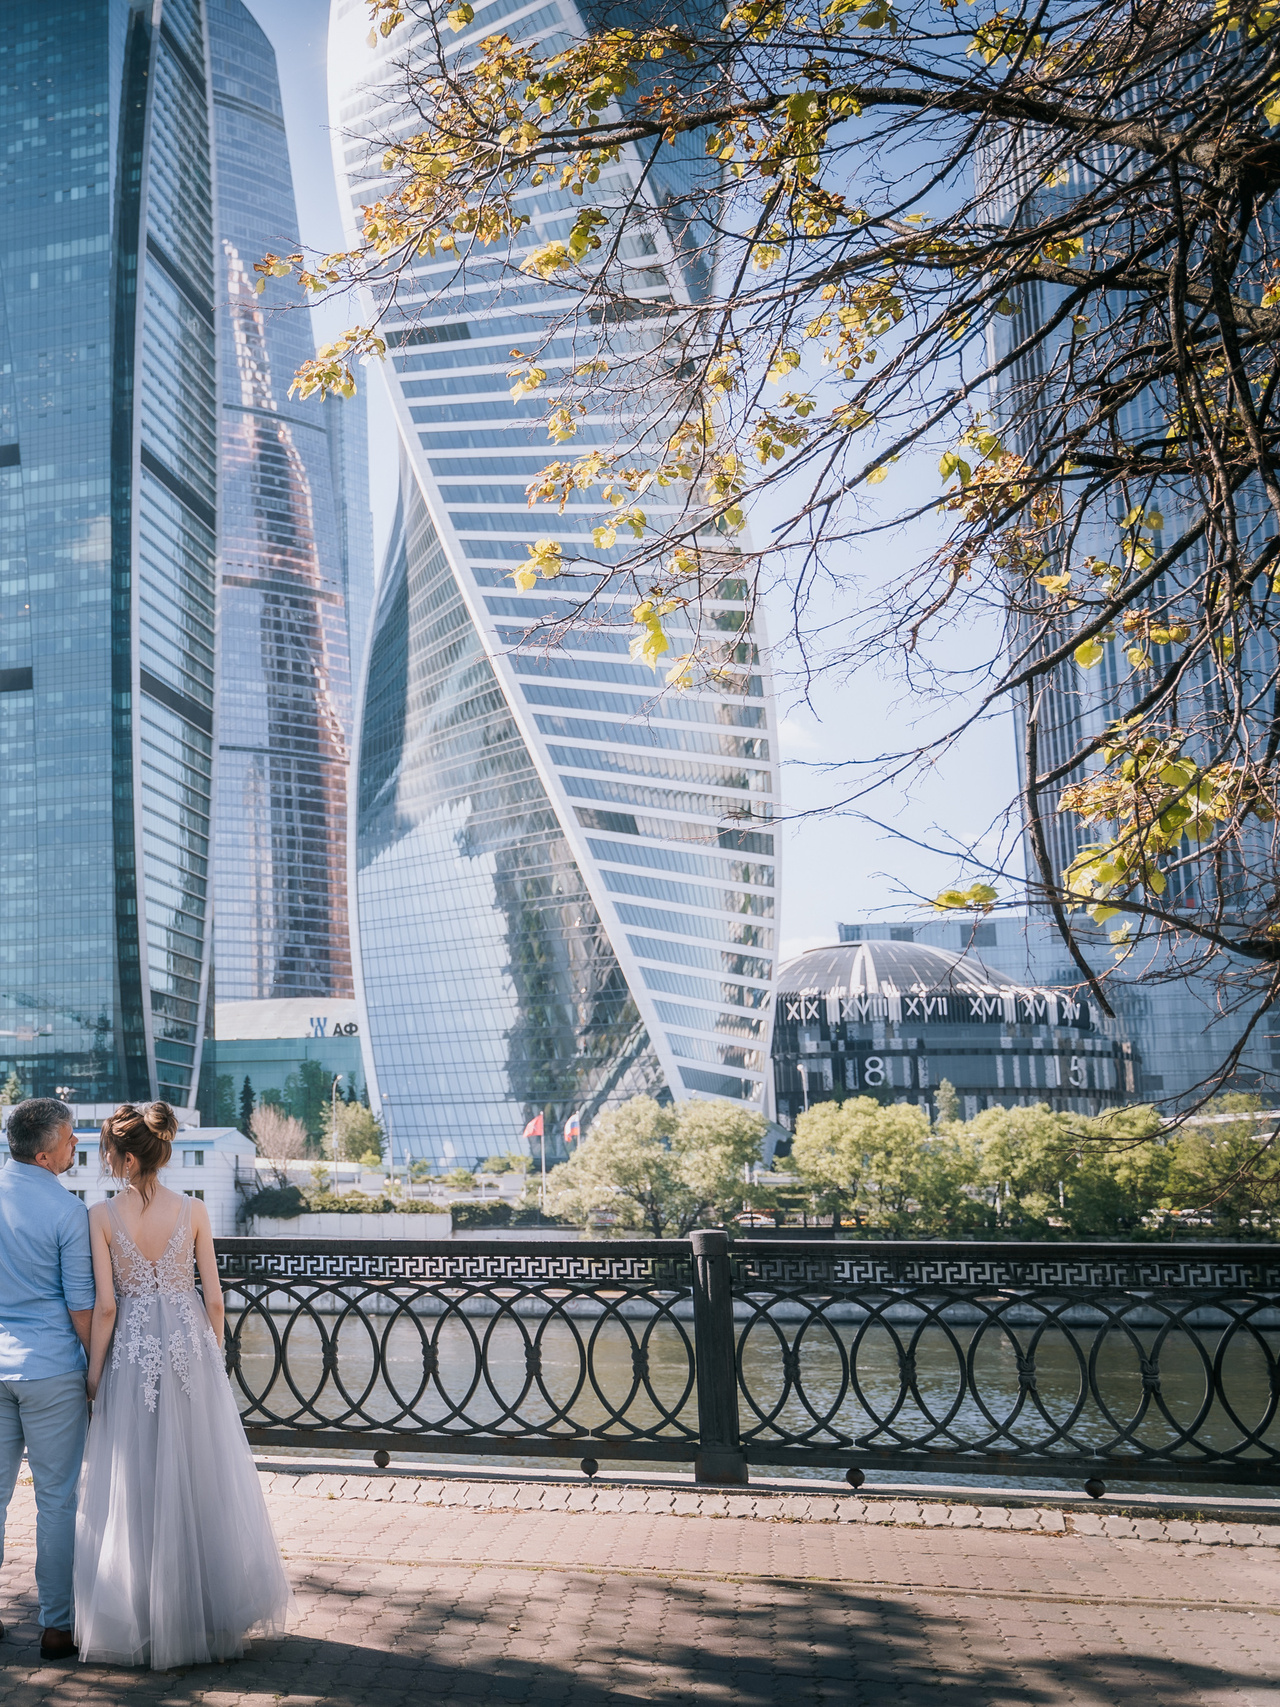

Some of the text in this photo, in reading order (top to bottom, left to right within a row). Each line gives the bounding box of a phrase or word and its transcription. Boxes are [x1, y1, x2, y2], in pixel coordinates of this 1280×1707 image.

[905, 997, 948, 1016] XVII
[969, 997, 1002, 1016] XVI
[1024, 998, 1046, 1017] XV
[1053, 1055, 1083, 1087] 15
